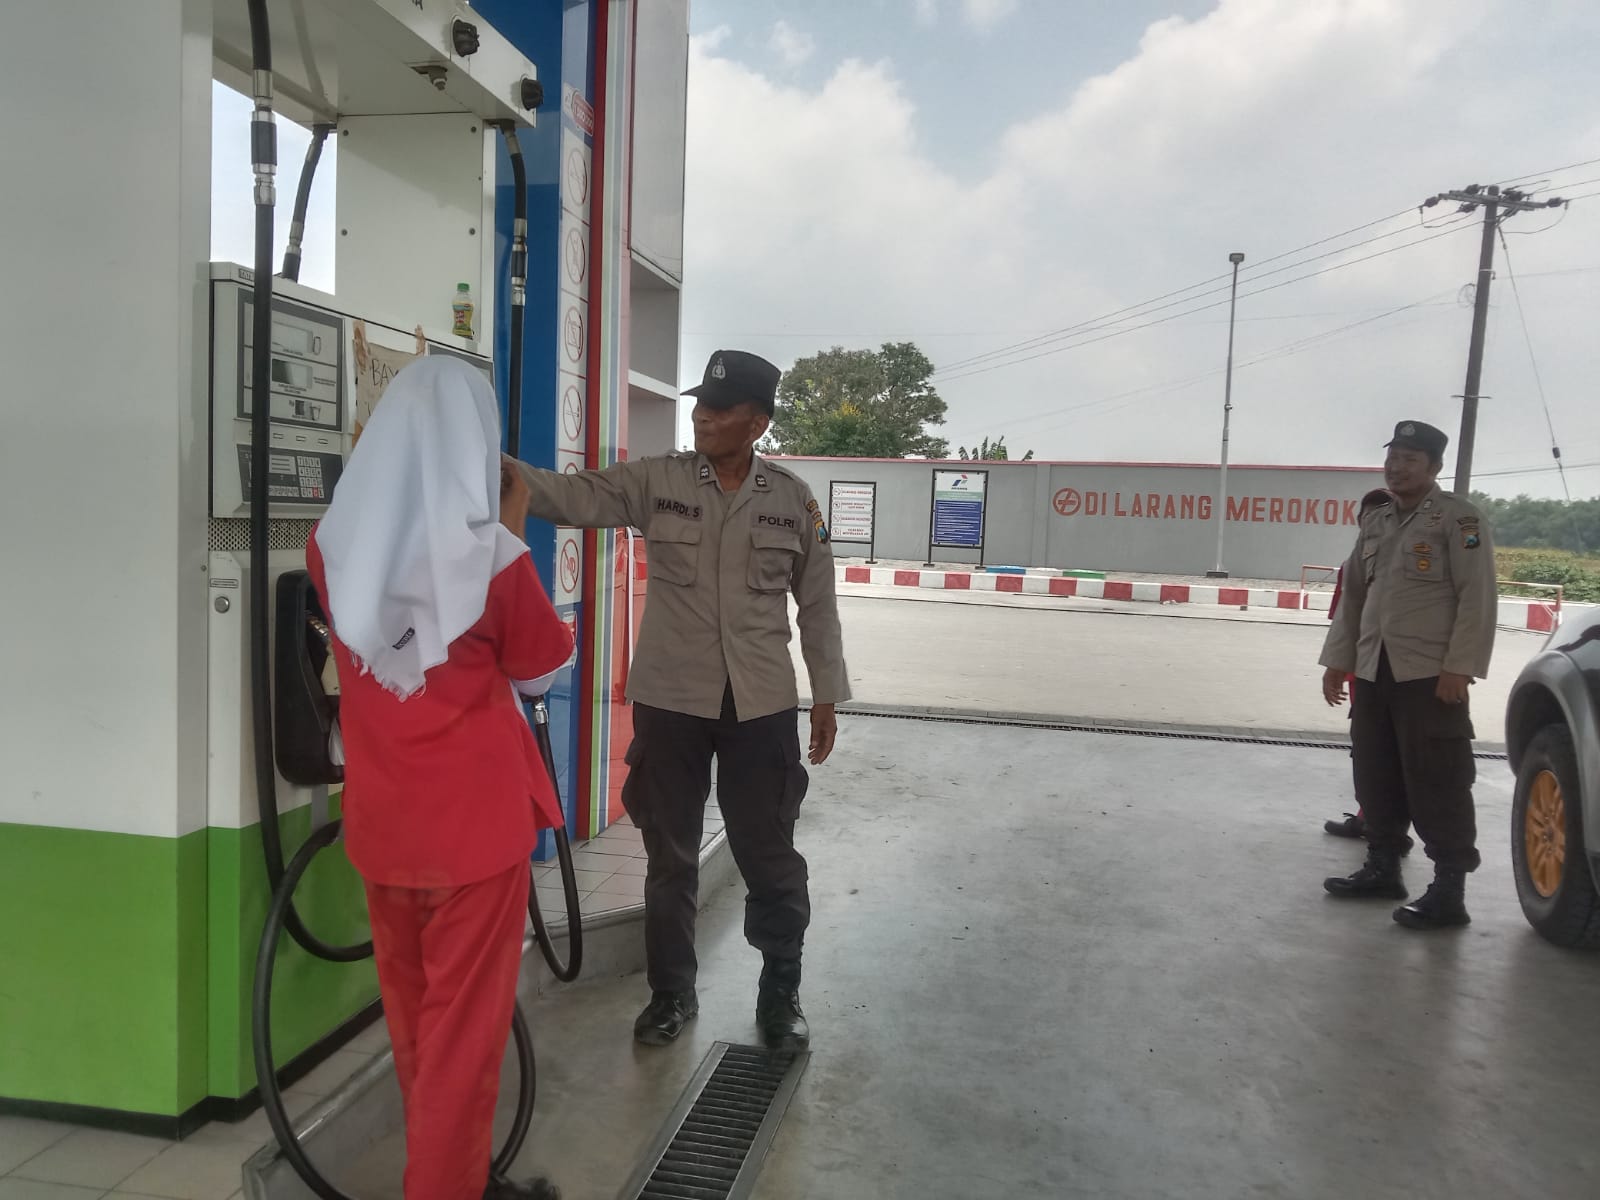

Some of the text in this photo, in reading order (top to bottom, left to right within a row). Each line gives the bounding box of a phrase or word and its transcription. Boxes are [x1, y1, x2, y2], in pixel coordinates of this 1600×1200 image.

[692, 507, 700, 518] S
[1226, 496, 1357, 526] MEROKOK
[758, 515, 795, 529] POLRI
